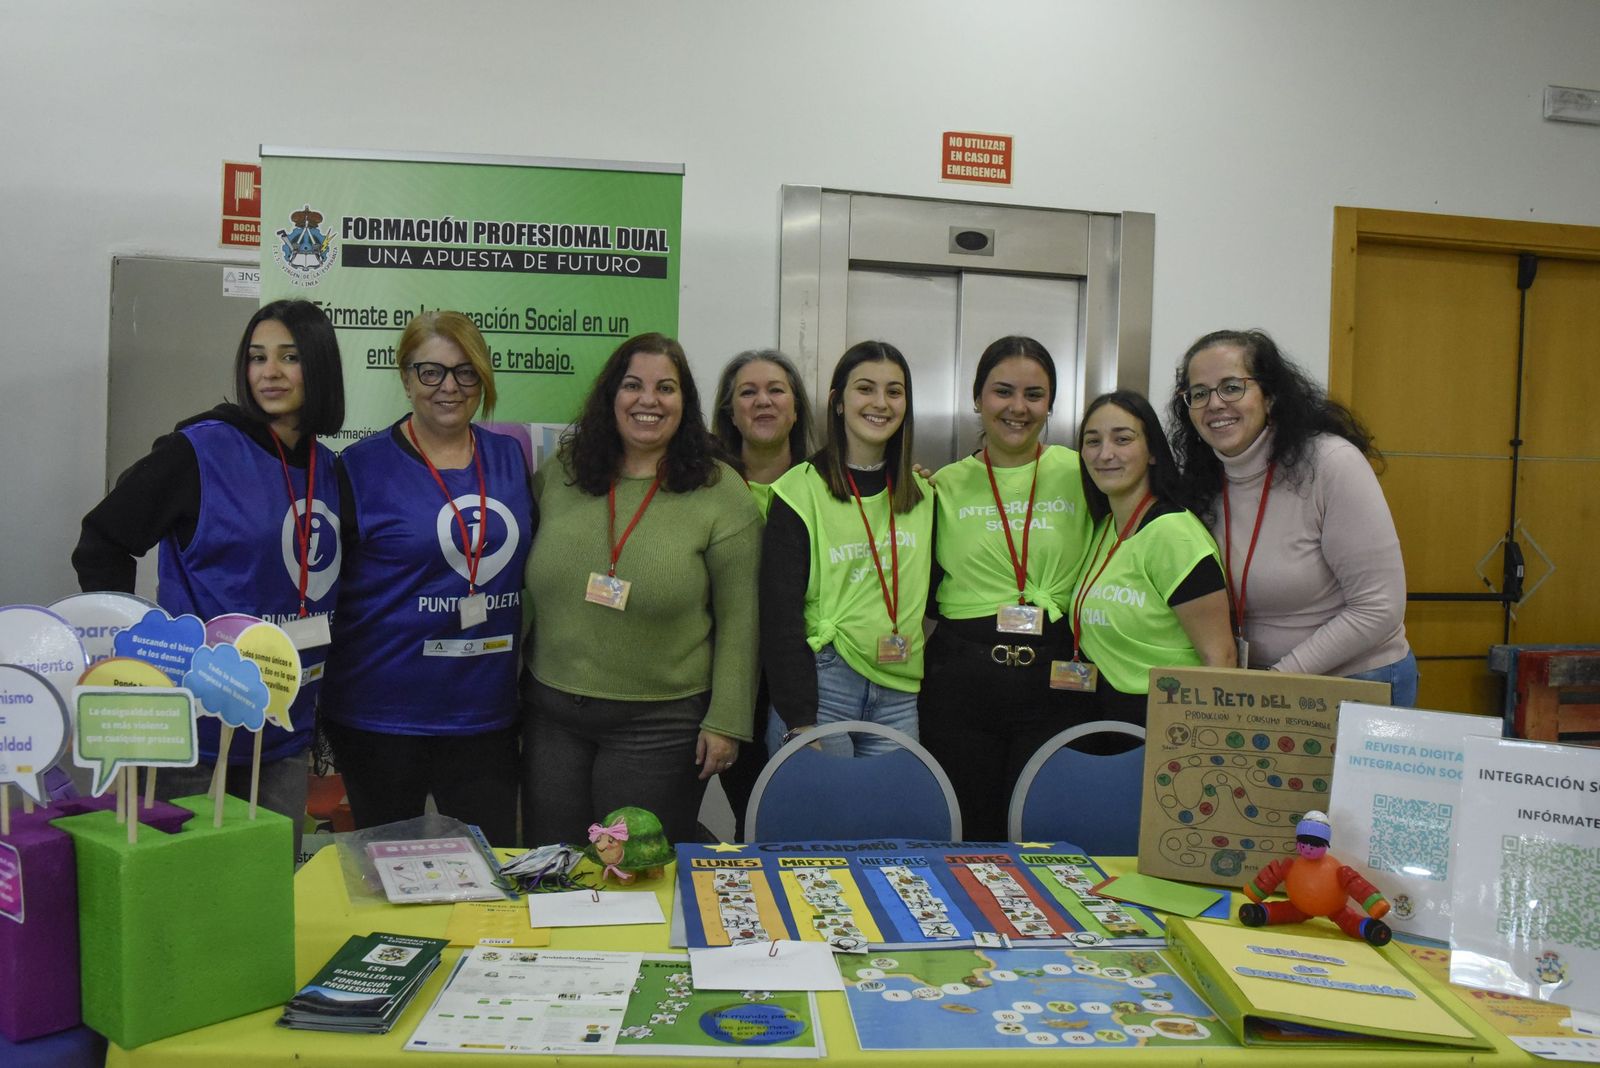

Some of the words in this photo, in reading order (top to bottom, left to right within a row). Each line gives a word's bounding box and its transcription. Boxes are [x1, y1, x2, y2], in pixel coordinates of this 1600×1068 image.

[949, 136, 962, 147] NO
[964, 138, 1006, 151] UTILIZAR
[950, 150, 962, 161] EN
[964, 151, 990, 164] CASO
[991, 154, 1004, 165] DE
[947, 164, 1007, 180] EMERGENCIA
[233, 223, 256, 233] BOCA
[342, 216, 468, 244] FORMACIÓN
[472, 221, 612, 249] PROFESIONAL
[616, 227, 669, 252] DUAL
[367, 247, 412, 265] UNA
[422, 249, 514, 269] APUESTA
[523, 253, 548, 270] DE
[557, 254, 641, 273] FUTURO
[313, 301, 388, 326] órmate
[525, 307, 577, 332] Social
[582, 315, 602, 332] en
[608, 316, 629, 333] un
[507, 346, 574, 375] trabajo.
[132, 634, 168, 649] Buscando
[178, 644, 195, 654] bien
[137, 648, 147, 657] de
[147, 649, 159, 659] los
[160, 652, 185, 664] demás
[255, 652, 271, 662] somos
[271, 656, 288, 667] únicos
[286, 674, 296, 682] que
[1180, 687, 1207, 705] EL
[1212, 686, 1255, 707] RETO
[1260, 694, 1291, 710] DEL
[1298, 696, 1327, 712] ODS
[1237, 713, 1242, 722] Y
[1246, 714, 1281, 725] CONSUMO
[1364, 740, 1417, 756] REVISTA
[1349, 755, 1436, 776] INTEGRACIÓN
[1479, 768, 1585, 791] INTEGRACIÓN
[1589, 781, 1600, 793] S
[385, 842, 458, 853] BINGO
[695, 859, 758, 867] LUNES
[781, 858, 848, 867] MARTES
[946, 854, 1011, 864] JUEVES
[1021, 855, 1089, 865] VIERNES
[333, 968, 406, 981] BACHILLERATO
[366, 965, 387, 973] ESO
[322, 981, 389, 994] PROFESIONAL
[332, 976, 392, 988] FORMACIÓN
